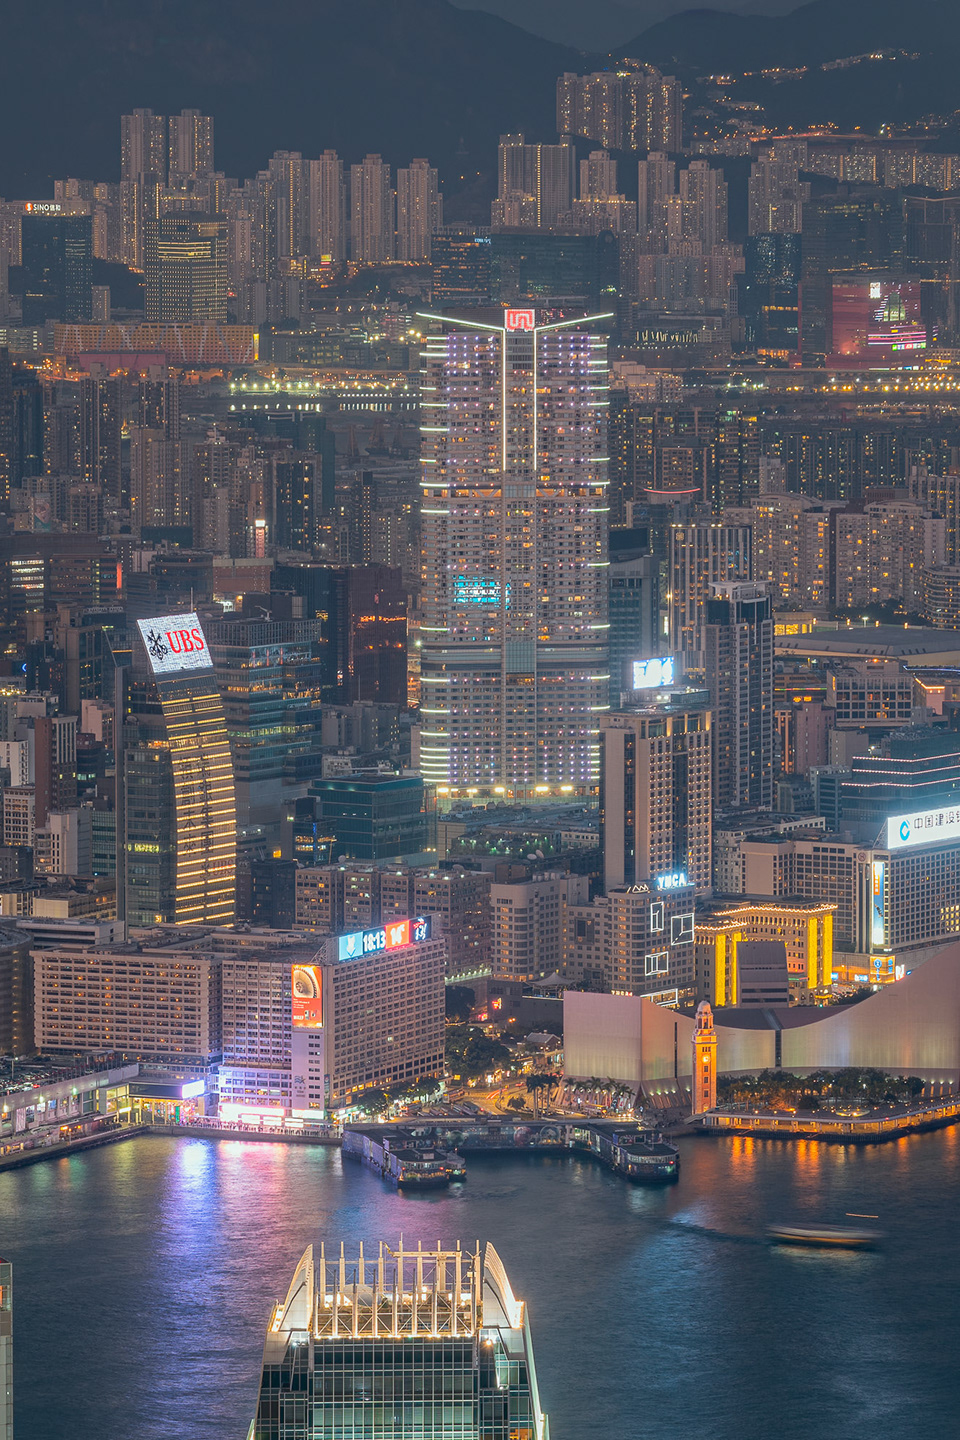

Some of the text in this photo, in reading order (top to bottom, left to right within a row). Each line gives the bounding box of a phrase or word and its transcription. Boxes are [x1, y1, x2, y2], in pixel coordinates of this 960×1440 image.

[165, 628, 204, 654] UBS
[658, 873, 687, 890] YMCA
[363, 930, 386, 952] 18:13
